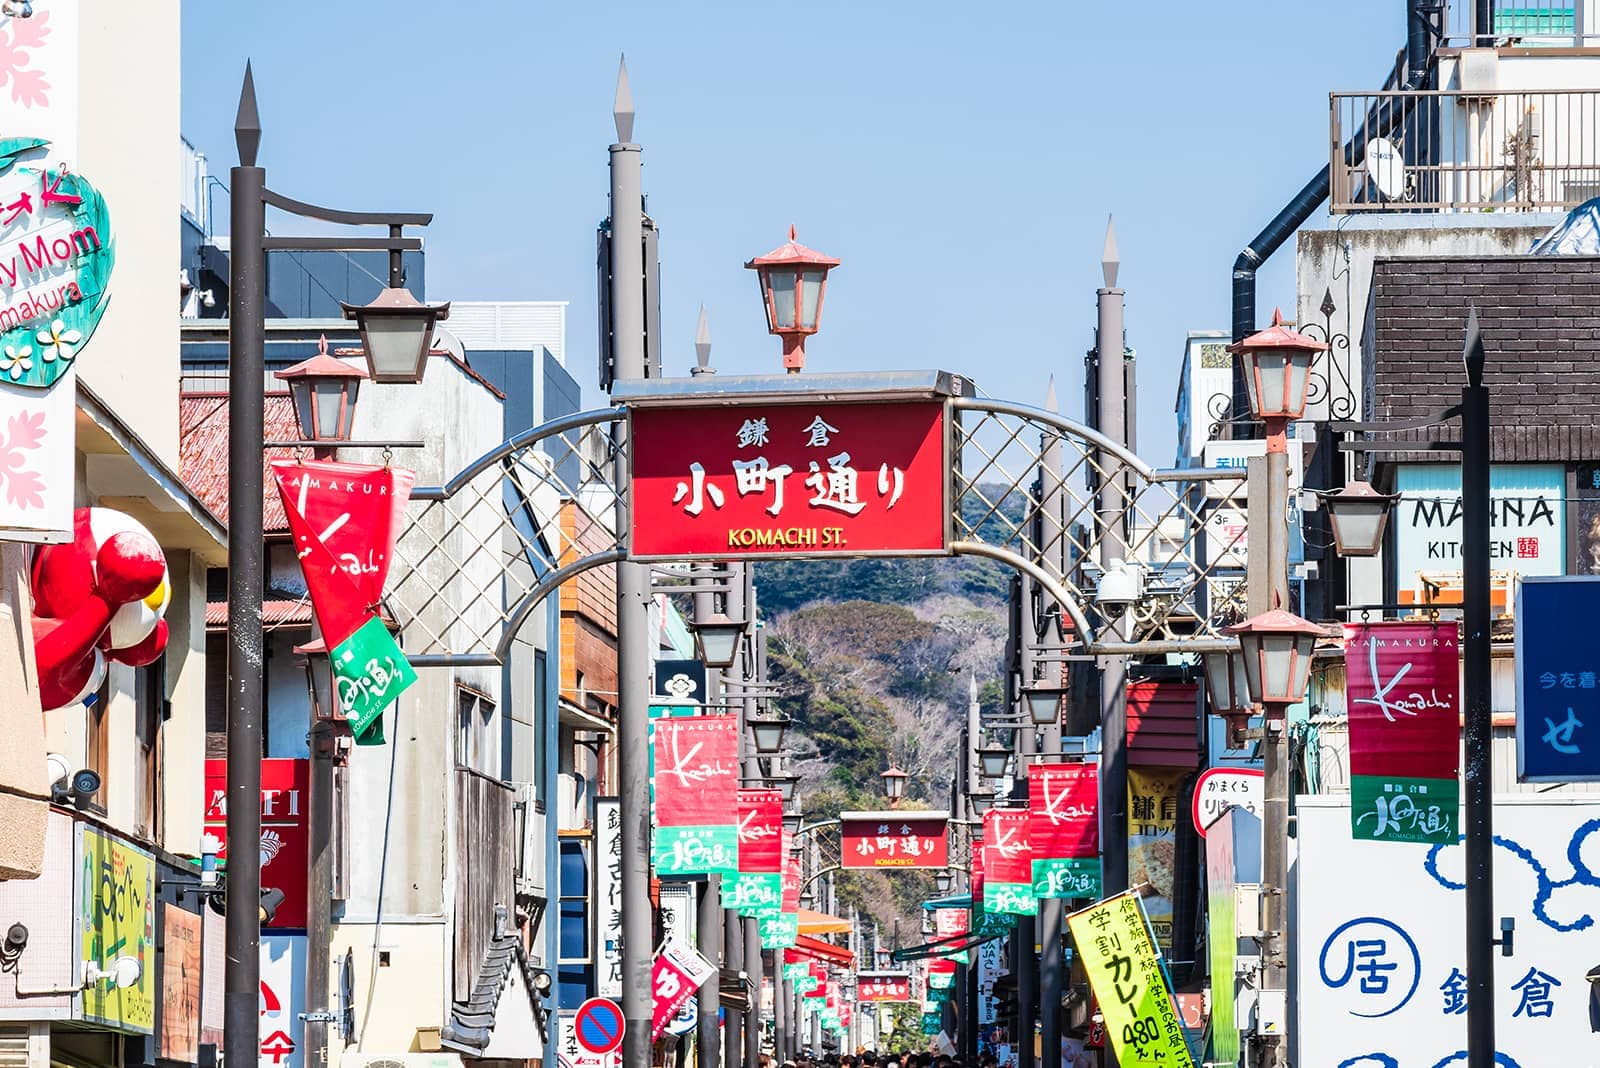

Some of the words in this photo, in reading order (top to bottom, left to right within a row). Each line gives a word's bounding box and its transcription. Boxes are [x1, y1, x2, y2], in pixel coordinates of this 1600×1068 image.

[18, 226, 100, 273] Mom
[736, 415, 839, 448] 鎌倉
[276, 474, 401, 496] KAMAKURA
[672, 451, 904, 517] 小町通り
[1412, 495, 1554, 528] MANA
[728, 527, 816, 547] KOMACHI
[822, 526, 848, 545] ST.
[1428, 541, 1513, 559] KITEN
[1350, 639, 1453, 648] KAMAKURA
[1353, 636, 1453, 722] Komachi
[1539, 671, 1600, 689] 今を着
[1542, 707, 1584, 754] せ
[1208, 780, 1249, 792] かまくら
[207, 789, 299, 816] AFI
[856, 835, 935, 856] 小町通り
[607, 807, 622, 983] 鎌倉古代美店
[1088, 907, 1138, 1018] 学割カレー
[1123, 1016, 1160, 1048] 480
[1136, 1048, 1166, 1061] えん
